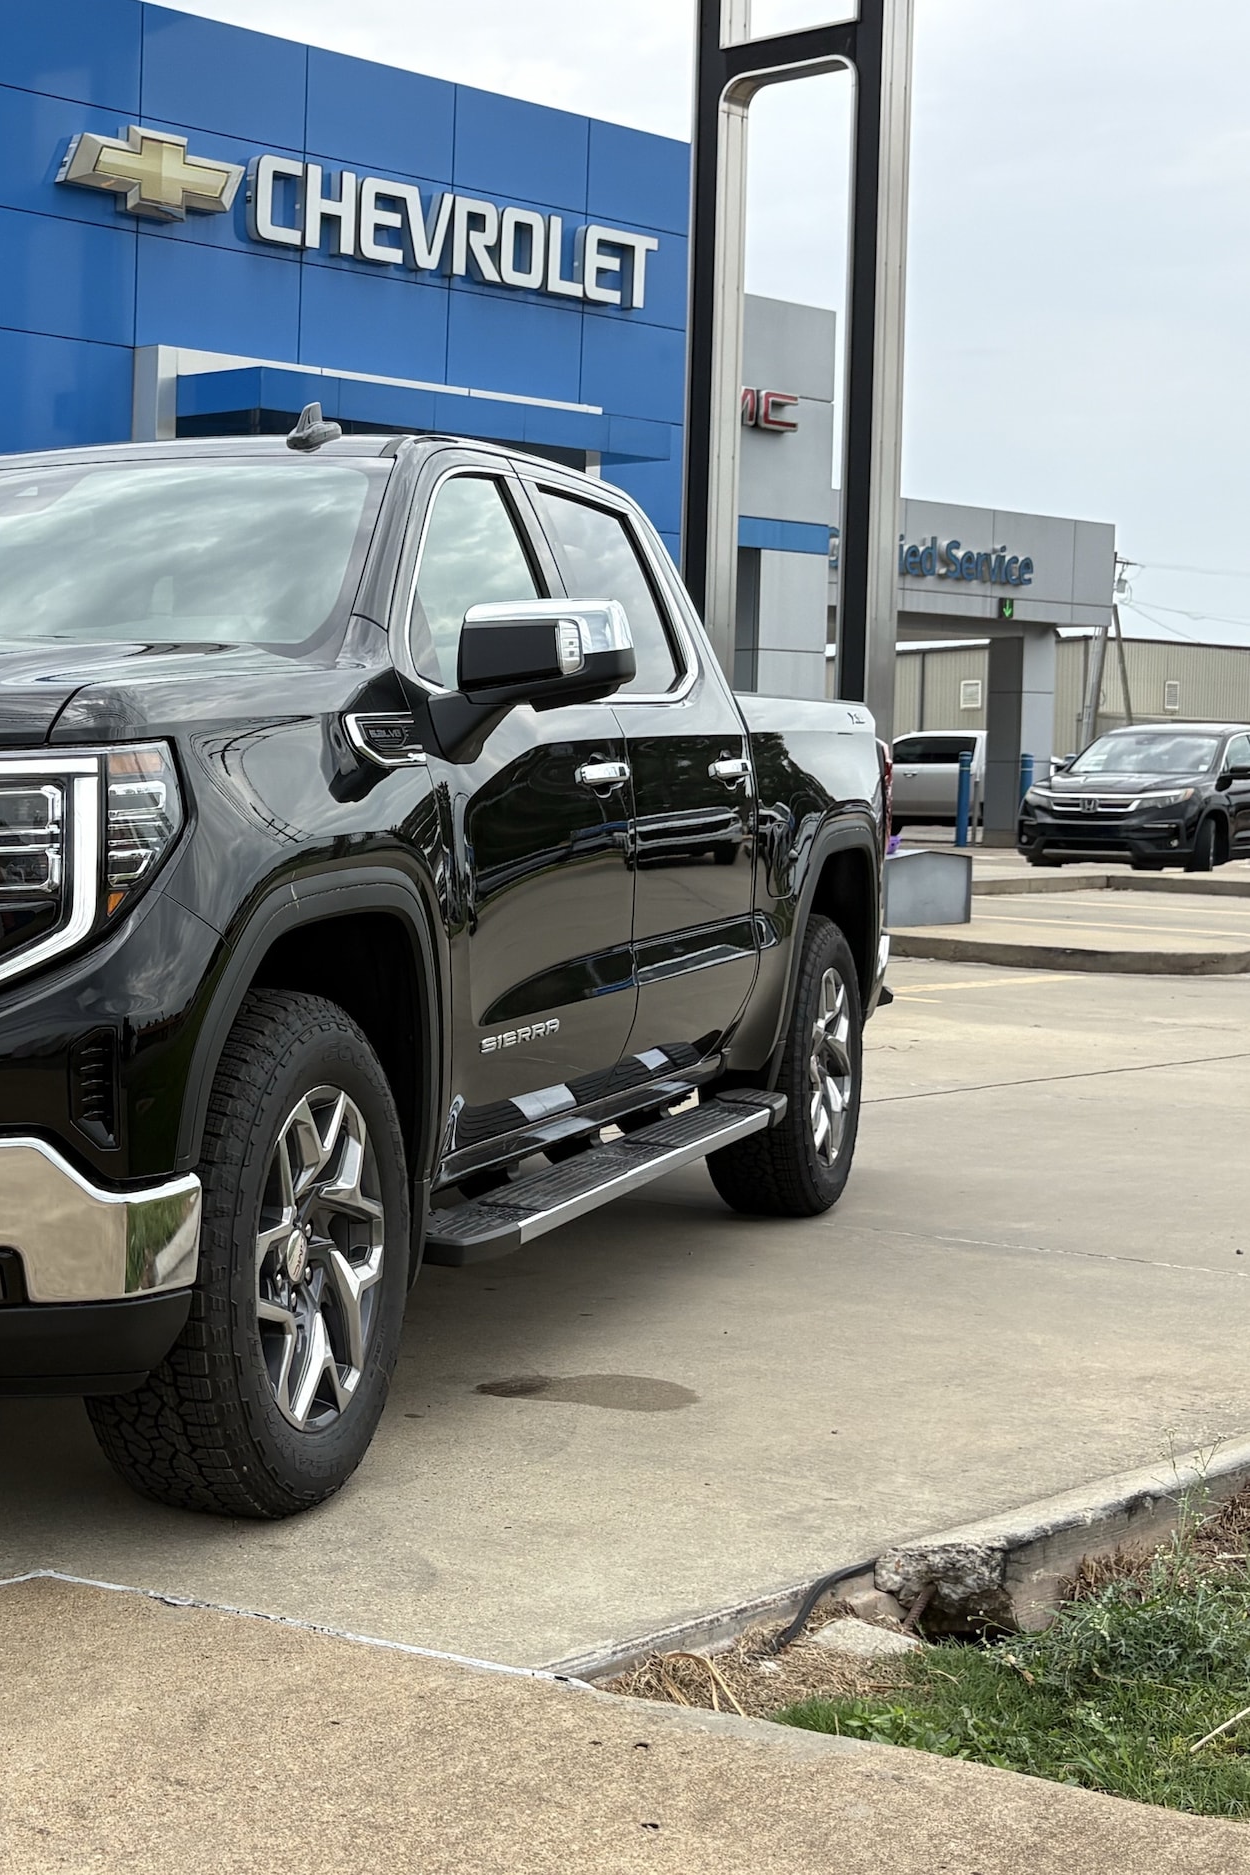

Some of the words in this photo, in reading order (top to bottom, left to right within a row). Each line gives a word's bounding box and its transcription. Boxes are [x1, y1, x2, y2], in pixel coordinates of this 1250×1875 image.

[253, 154, 659, 309] CHEVROLET
[945, 539, 1034, 586] Service
[479, 1018, 560, 1054] SIERRA
